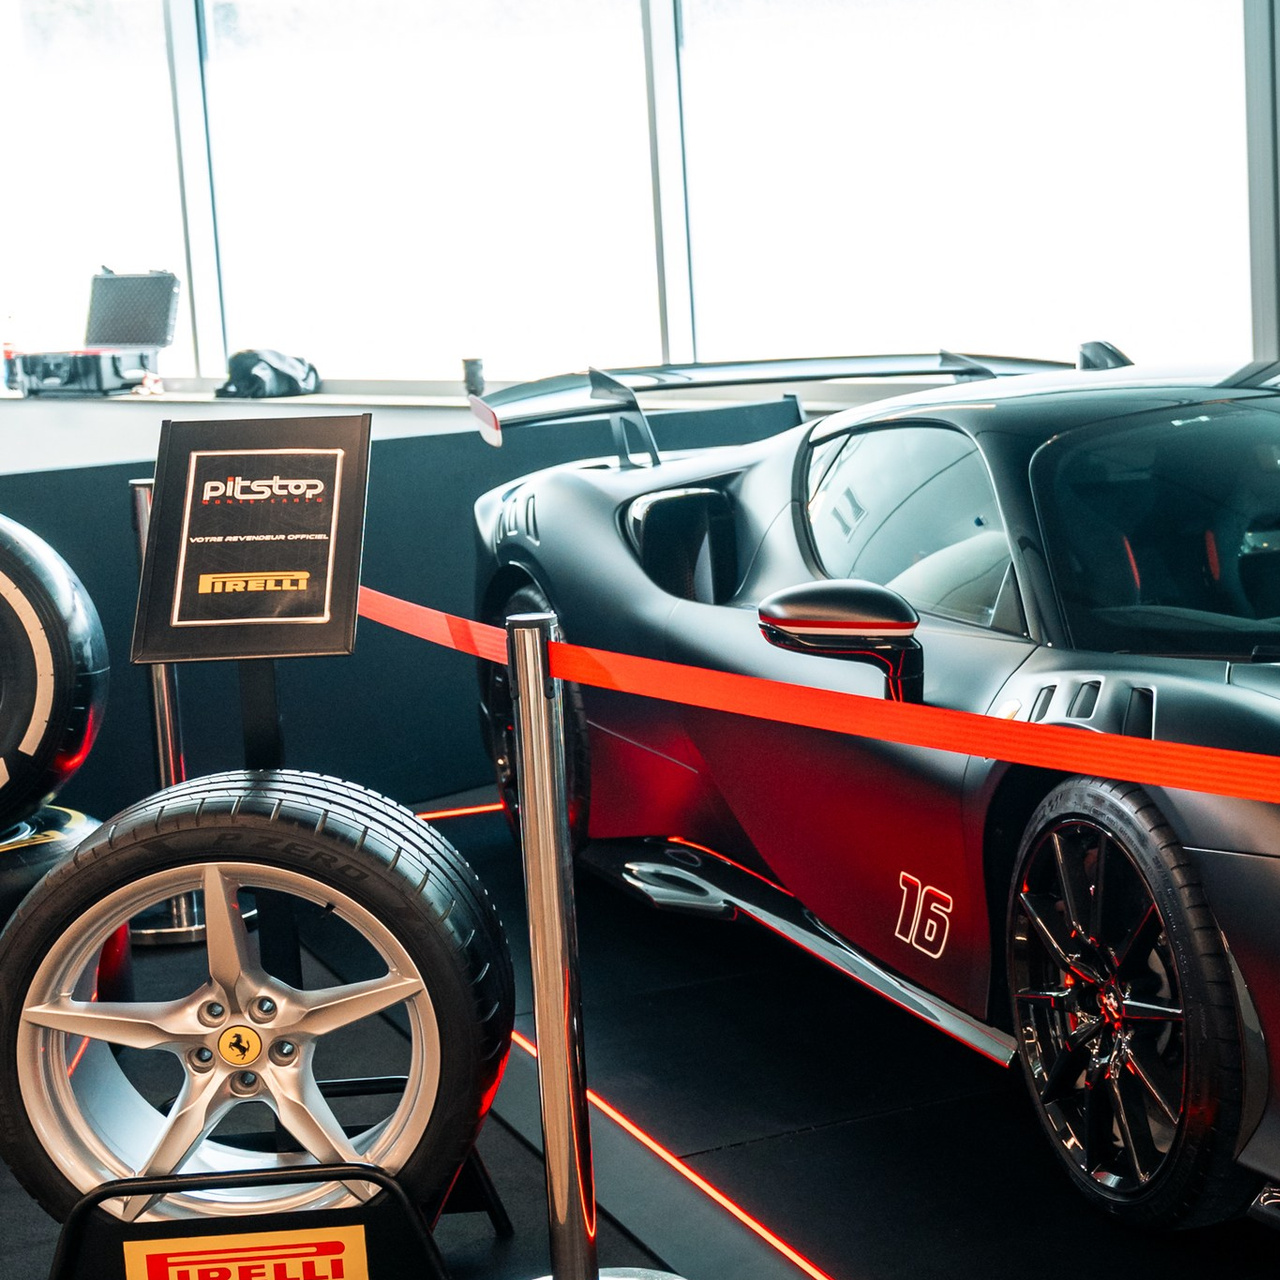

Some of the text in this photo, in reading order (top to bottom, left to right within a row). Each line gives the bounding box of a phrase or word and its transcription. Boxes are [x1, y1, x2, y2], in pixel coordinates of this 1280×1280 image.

[203, 476, 324, 501] pitstop
[189, 533, 329, 544] VOTRE REVENDEUR OFFICIEL
[198, 571, 310, 594] PIRELLI
[253, 834, 370, 883] ZERO
[895, 871, 953, 959] 16
